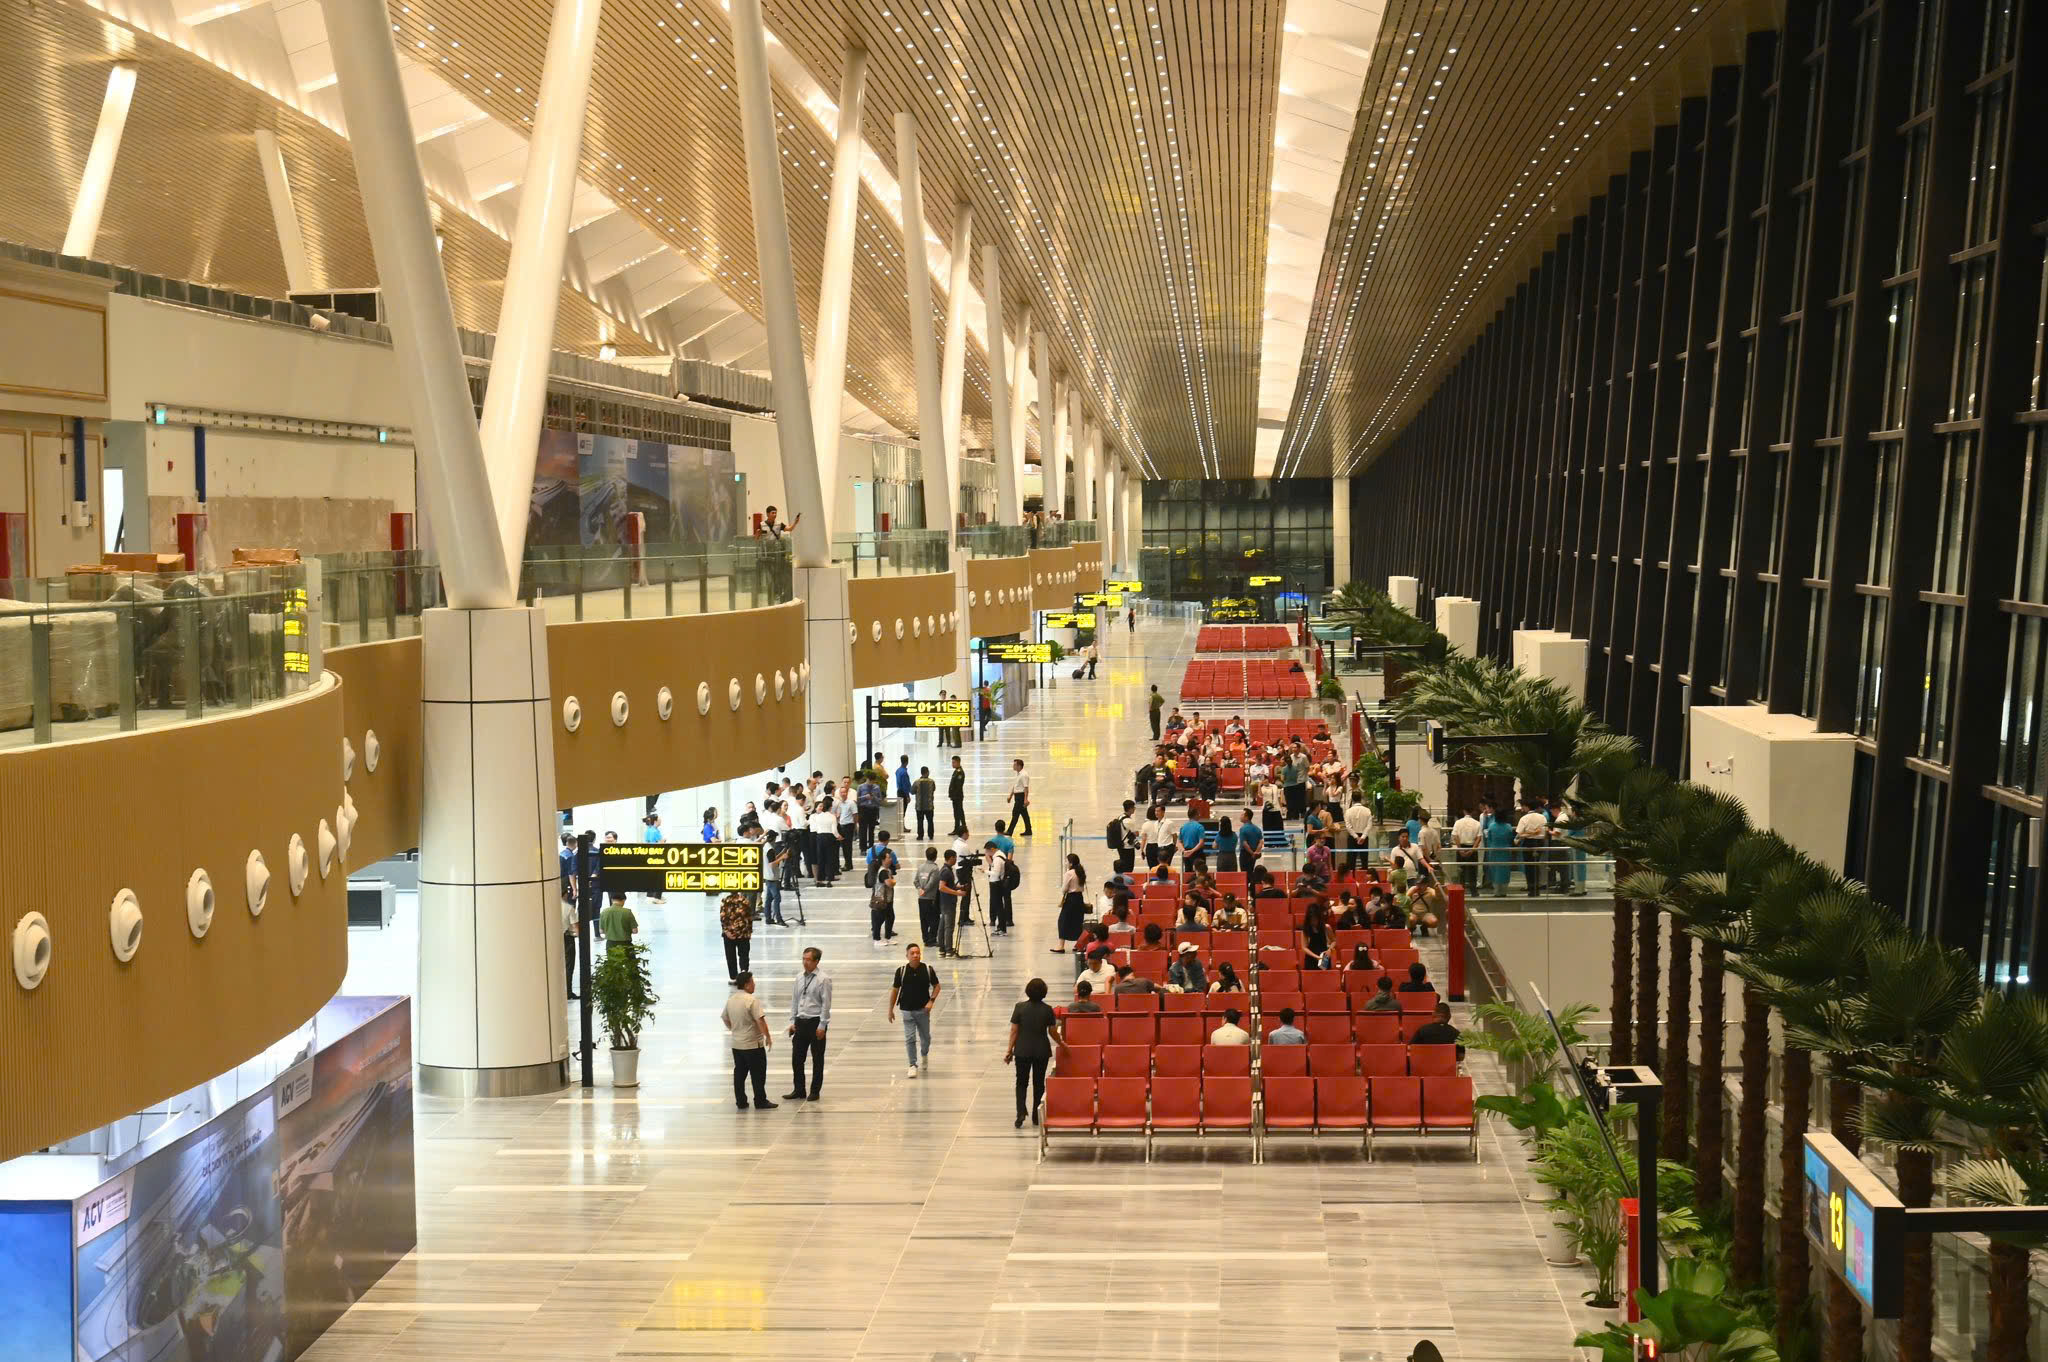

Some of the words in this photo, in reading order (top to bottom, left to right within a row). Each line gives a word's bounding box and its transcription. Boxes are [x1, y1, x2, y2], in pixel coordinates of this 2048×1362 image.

[917, 701, 947, 713] 01-11
[667, 847, 719, 865] 01-12
[280, 1080, 294, 1108] ACV
[82, 1198, 104, 1232] ACV
[1830, 1191, 1843, 1251] 13
